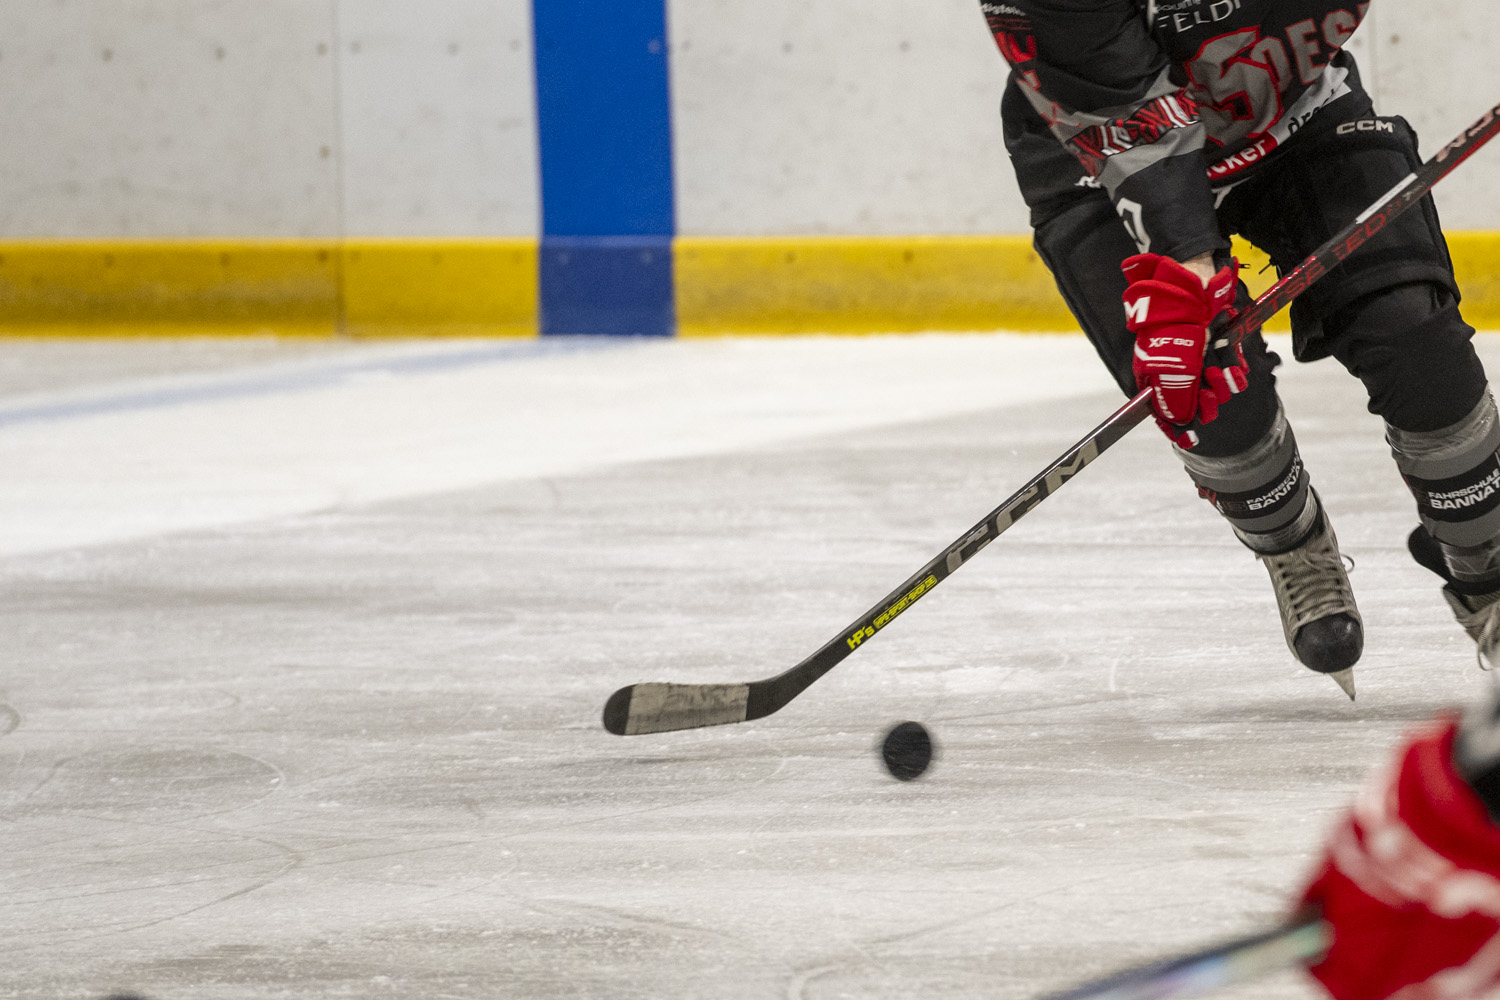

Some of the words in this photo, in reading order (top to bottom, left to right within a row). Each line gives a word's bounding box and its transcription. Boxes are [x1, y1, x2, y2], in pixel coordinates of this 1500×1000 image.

[1336, 119, 1394, 134] CCM
[1428, 468, 1500, 499] FAHRSCHULE
[1430, 476, 1500, 509] BANNAT
[946, 437, 1099, 574] CCM
